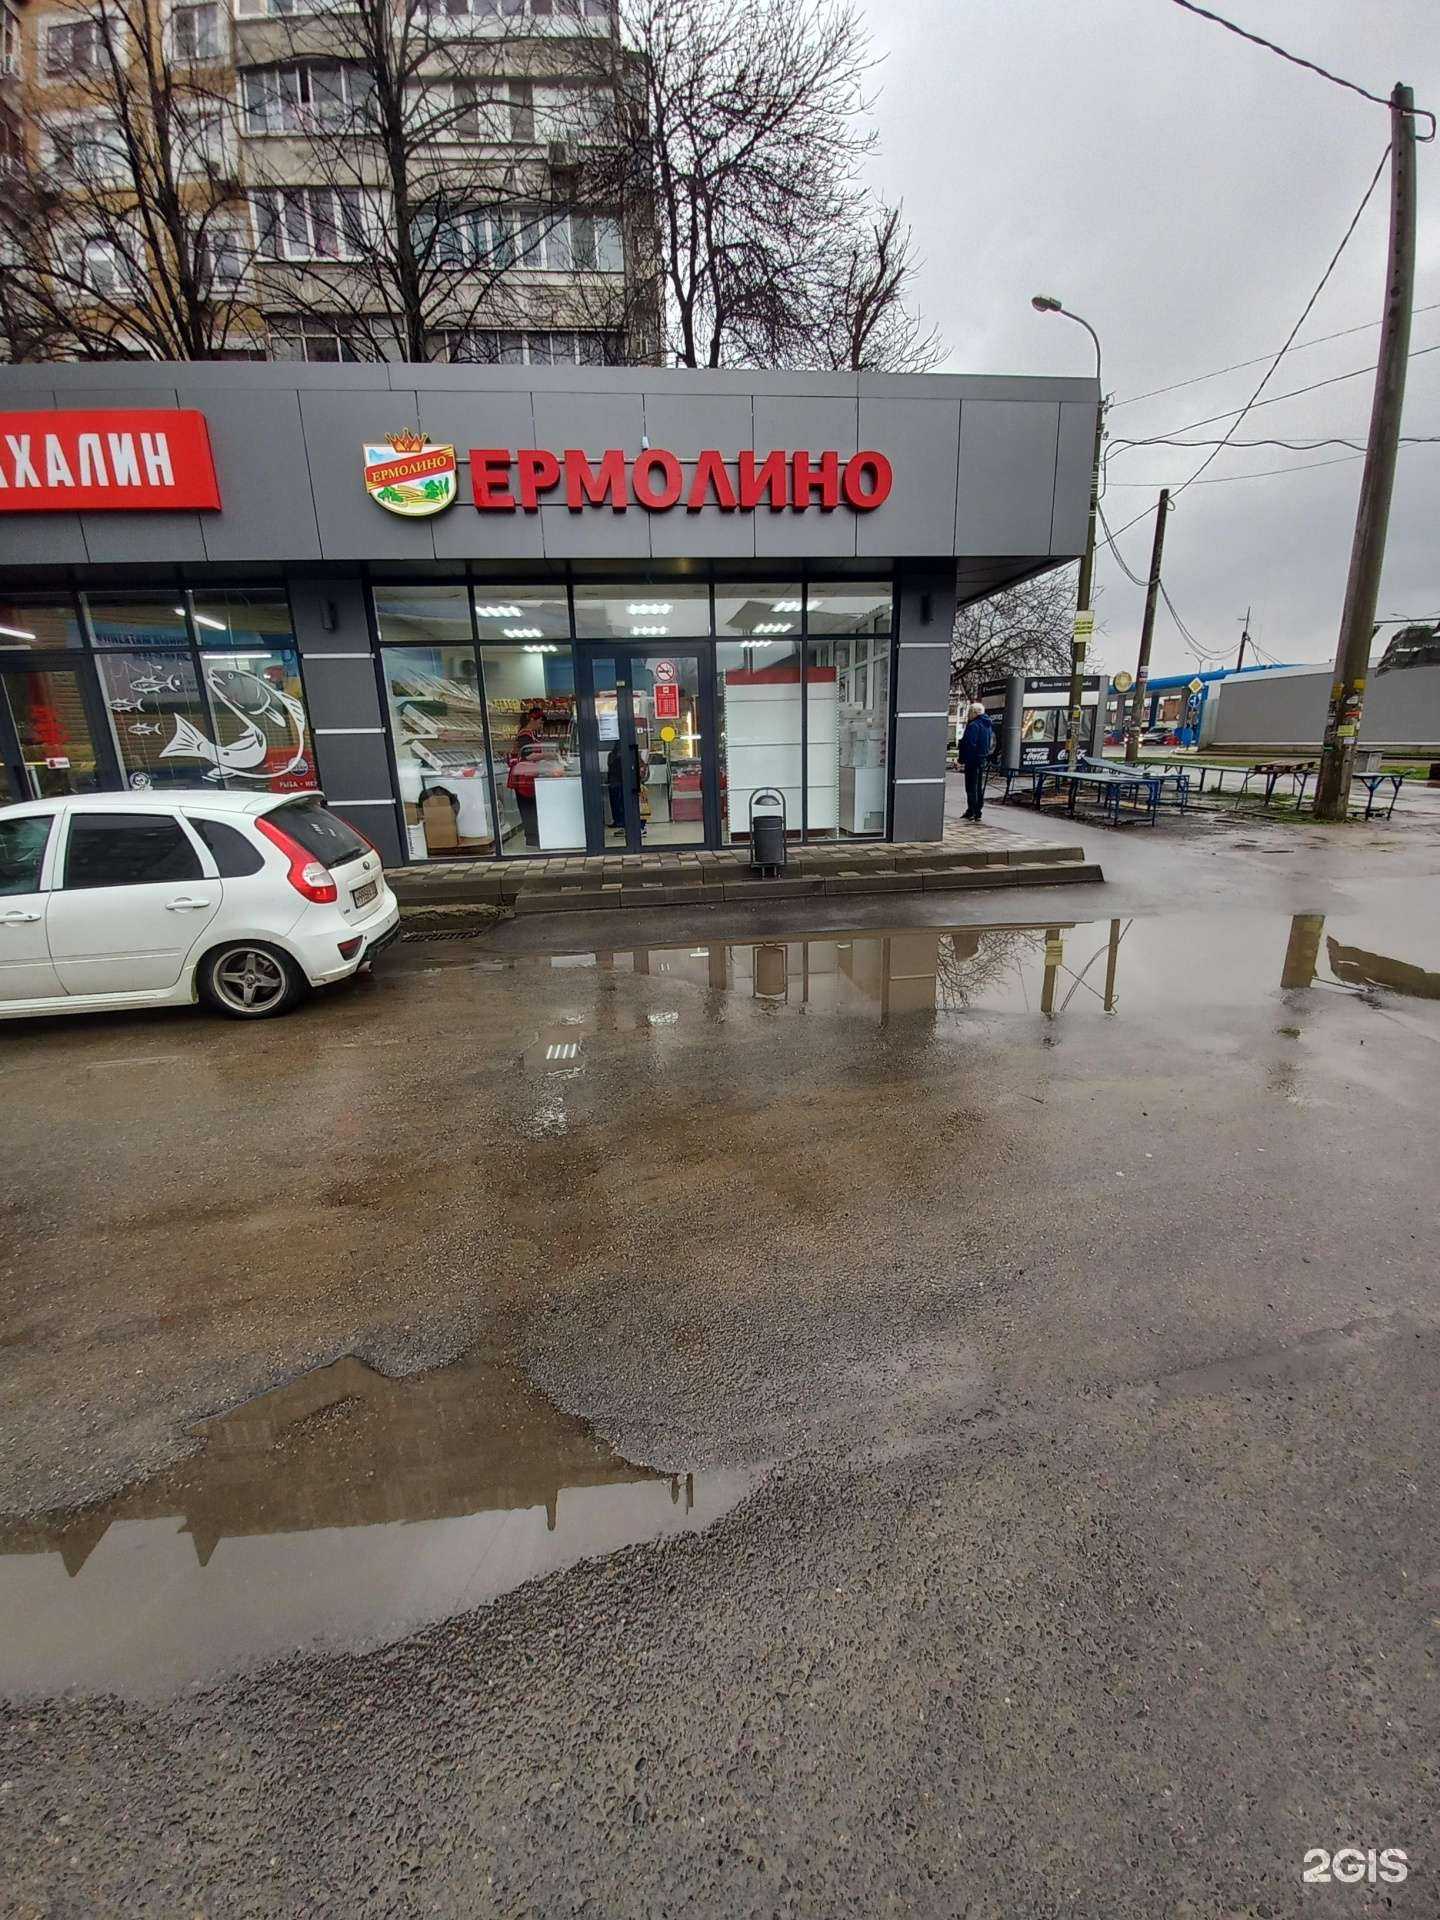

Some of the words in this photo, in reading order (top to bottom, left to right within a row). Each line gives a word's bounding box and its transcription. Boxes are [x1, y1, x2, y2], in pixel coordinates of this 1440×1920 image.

[0, 433, 176, 488] ХАЛИН
[371, 456, 447, 482] ЕРМОЛИНО
[469, 449, 893, 513] ЕРМОЛИНО
